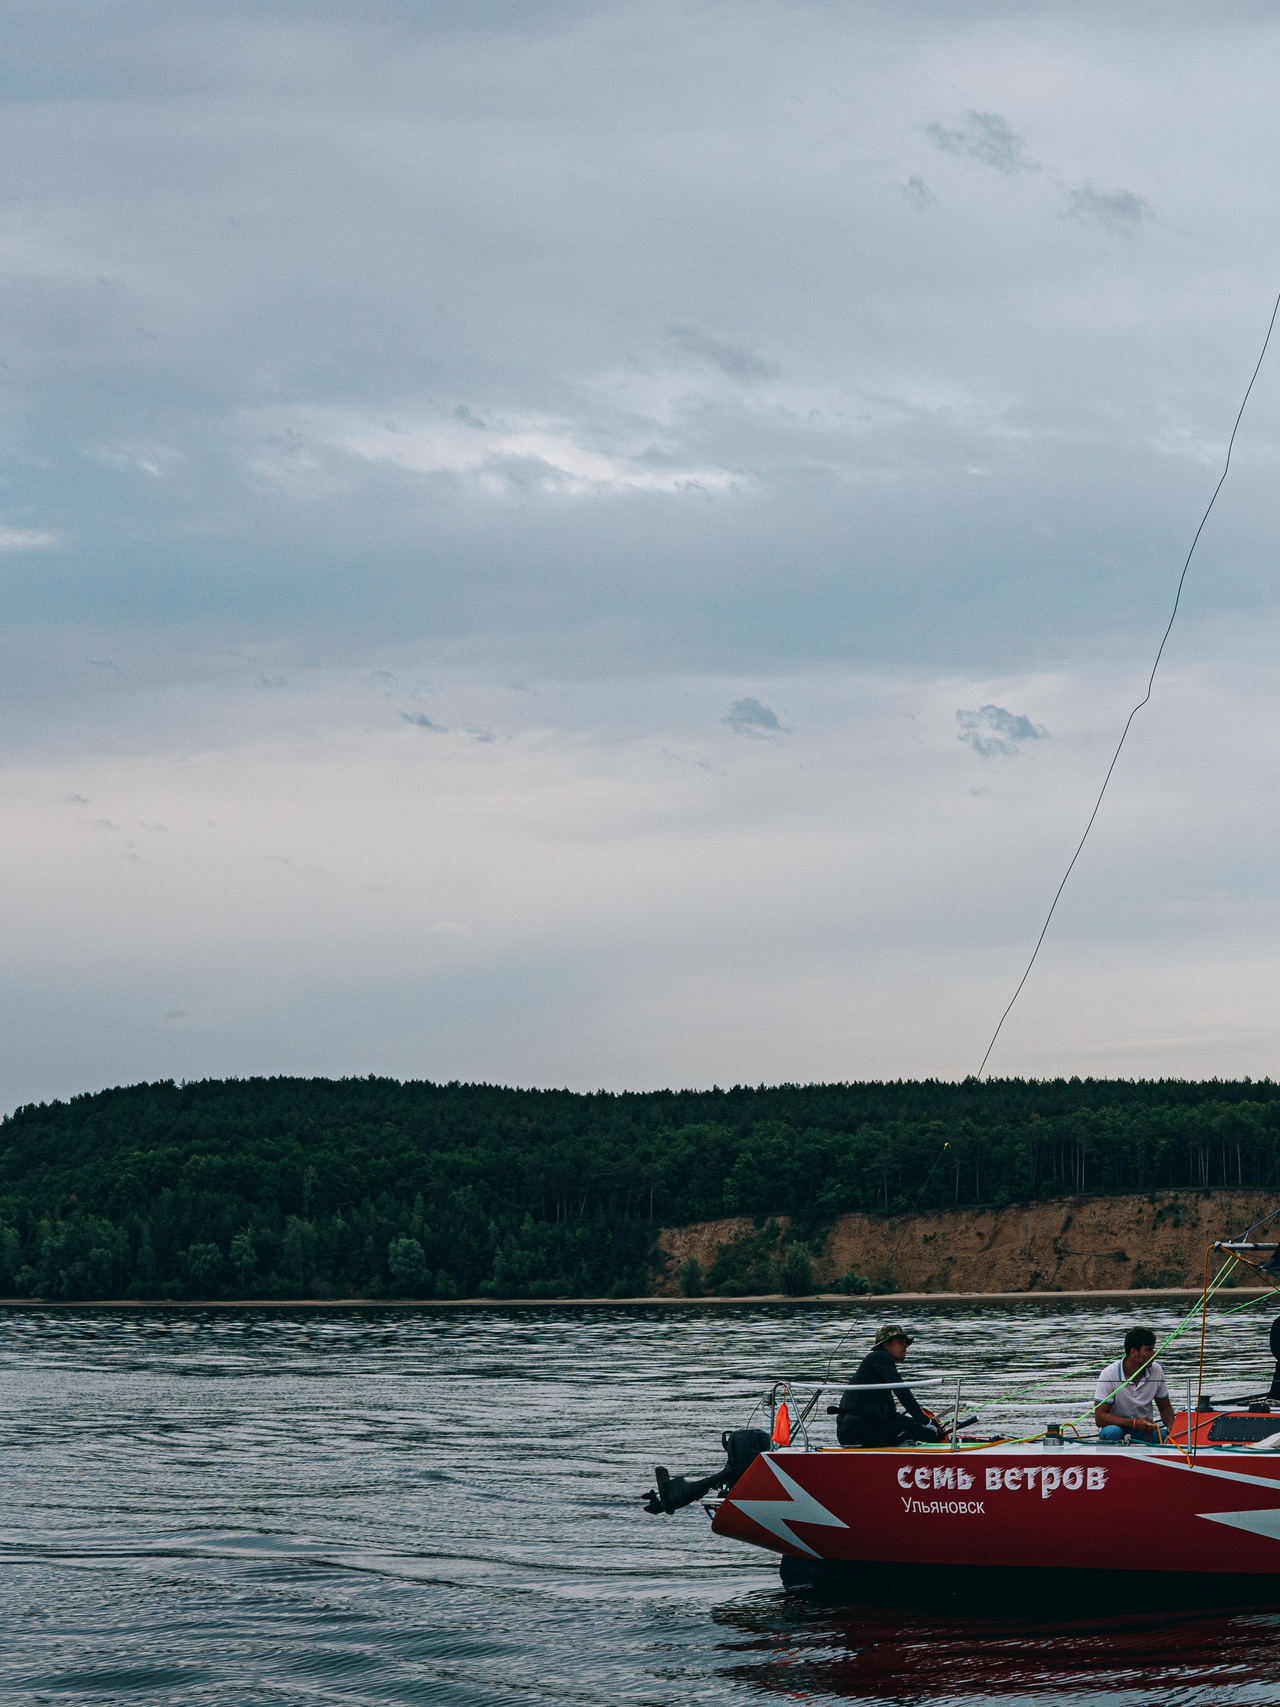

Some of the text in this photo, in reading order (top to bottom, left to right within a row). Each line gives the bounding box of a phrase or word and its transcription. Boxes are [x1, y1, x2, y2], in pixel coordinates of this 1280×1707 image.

[897, 1464, 1110, 1499] семь ветров
[901, 1497, 986, 1514] Ульяновск
